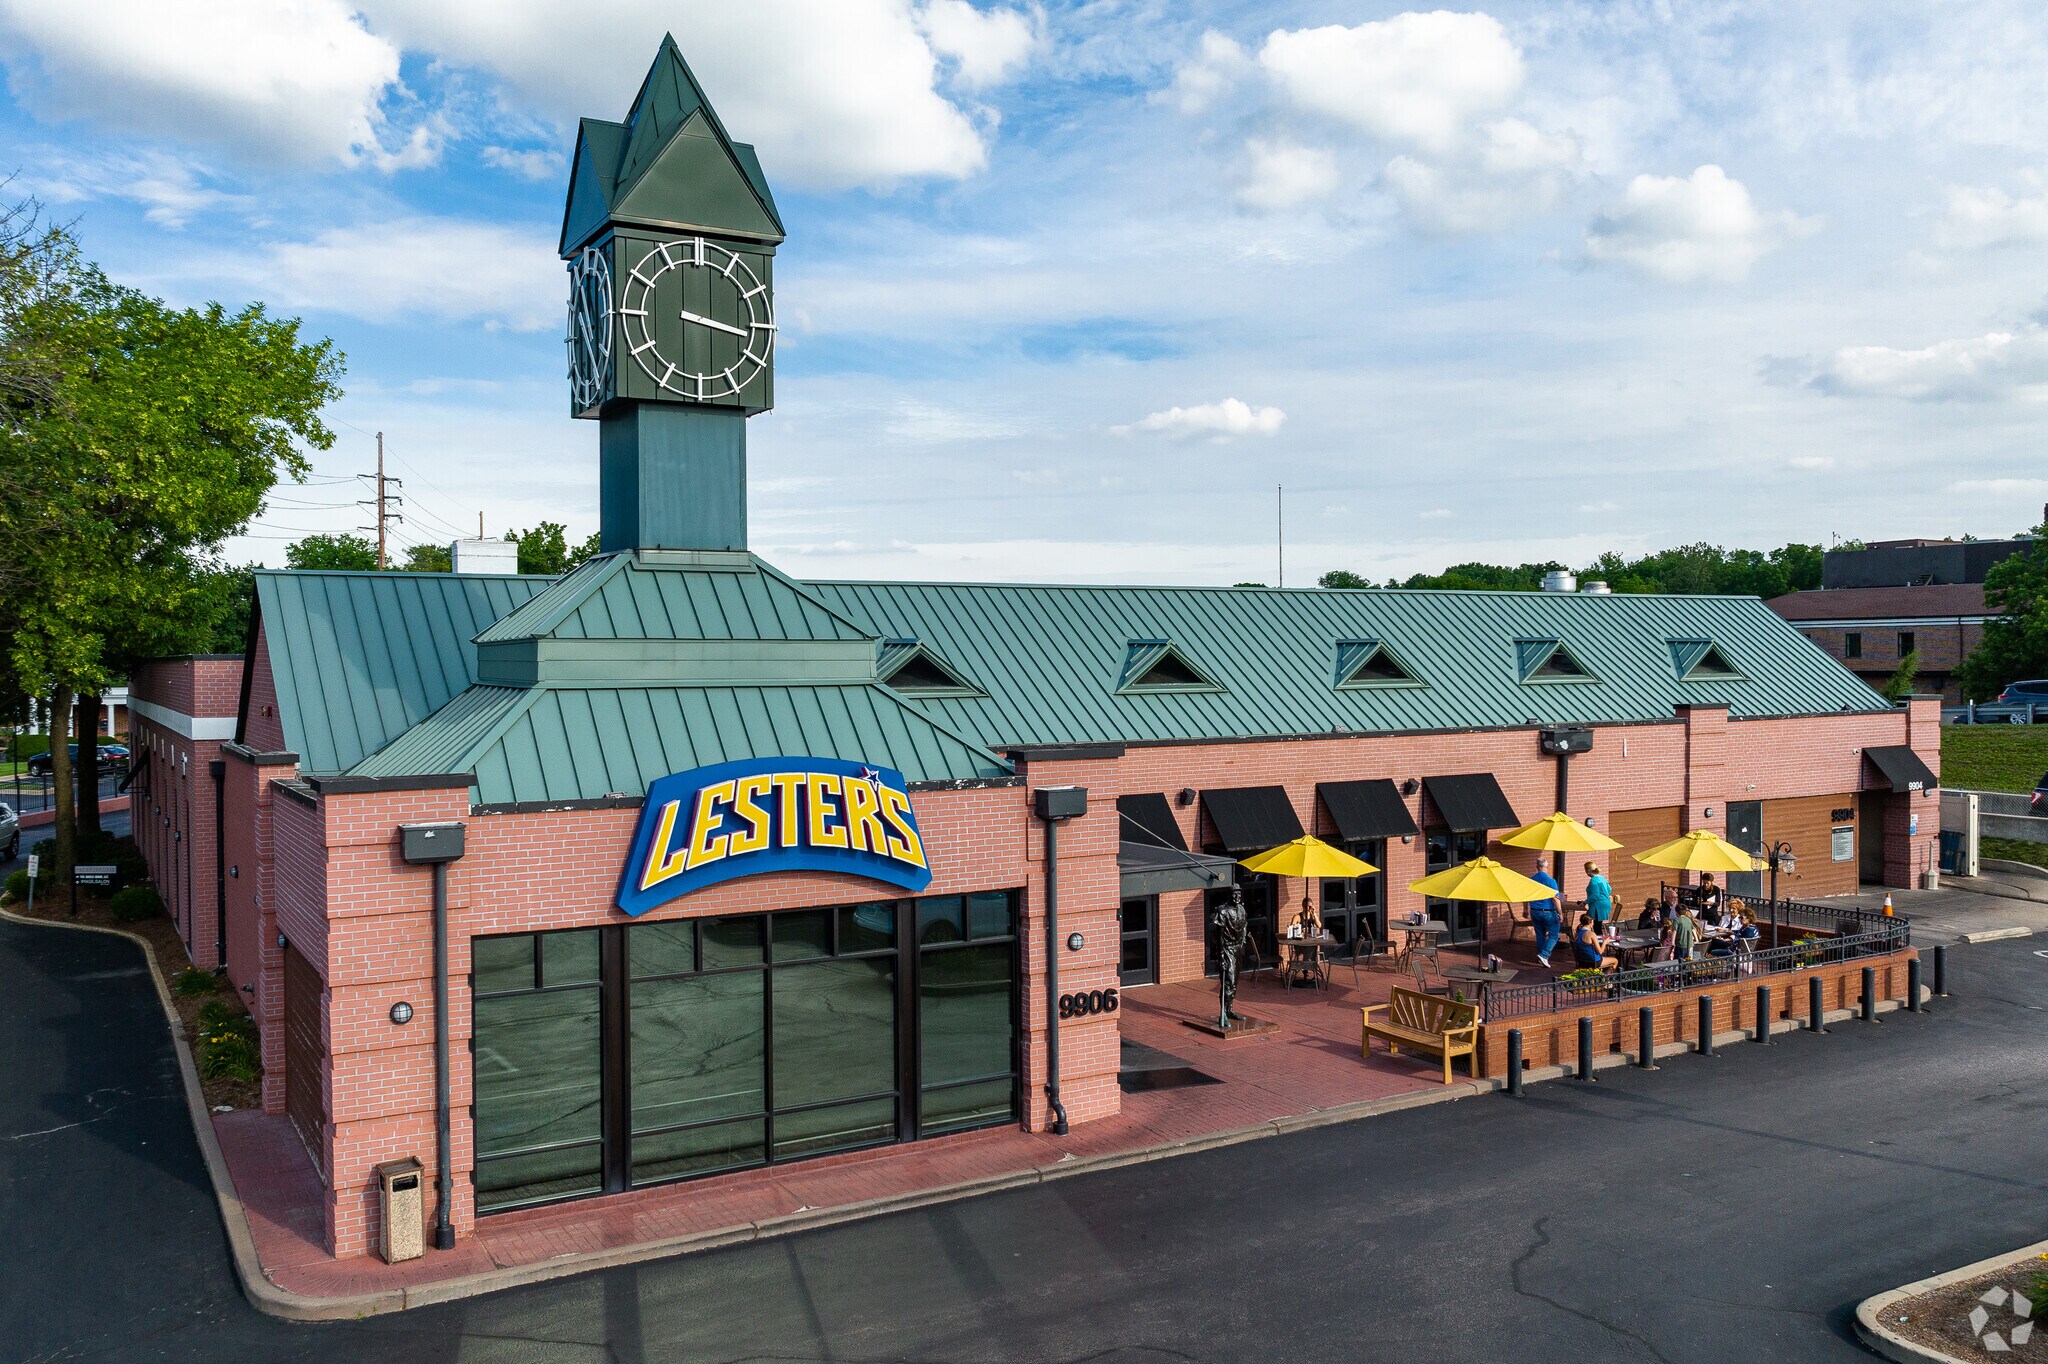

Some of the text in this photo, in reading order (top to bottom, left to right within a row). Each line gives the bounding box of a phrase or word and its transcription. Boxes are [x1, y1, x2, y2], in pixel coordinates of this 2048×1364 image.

[1908, 781, 1923, 790] 9904
[1831, 808, 1854, 822] 9904
[1059, 988, 1118, 1018] 9906
